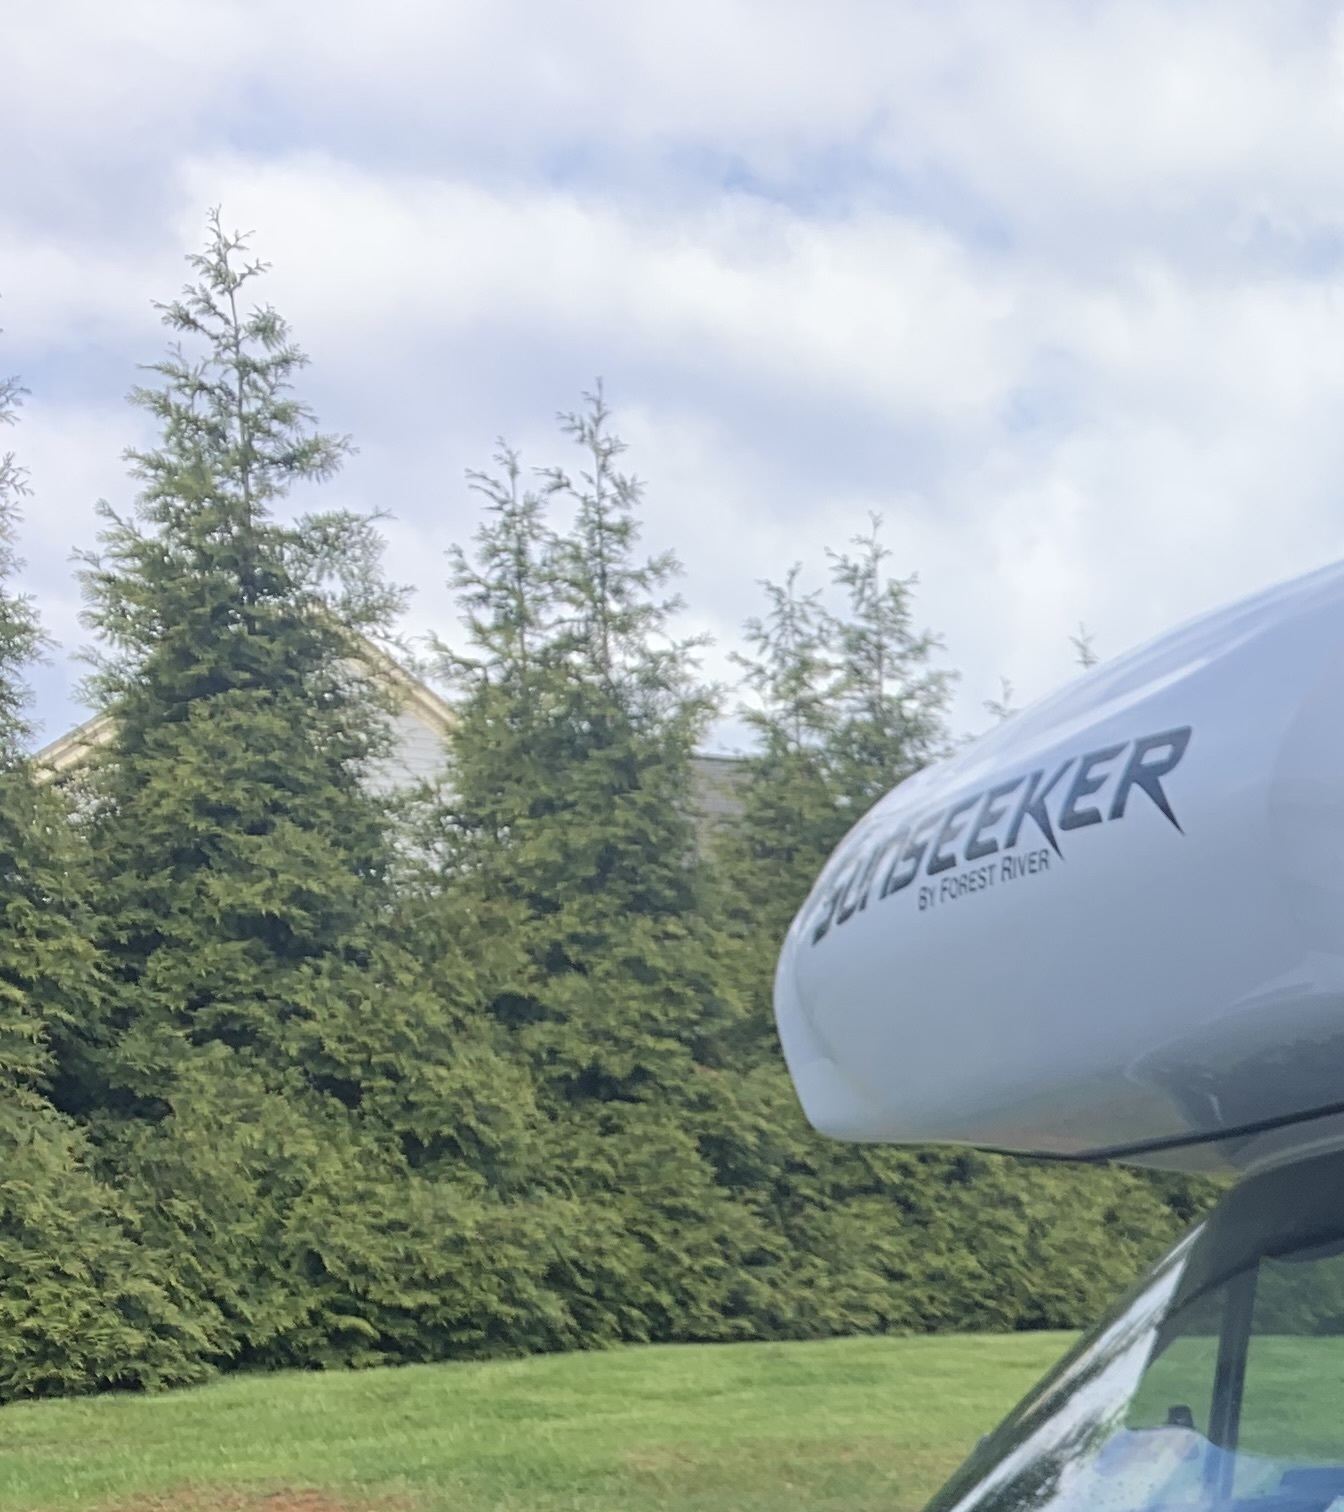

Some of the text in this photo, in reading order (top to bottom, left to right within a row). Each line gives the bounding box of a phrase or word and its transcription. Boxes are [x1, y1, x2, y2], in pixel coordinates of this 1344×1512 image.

[918, 848, 1050, 912] BY FOREST RIVER
